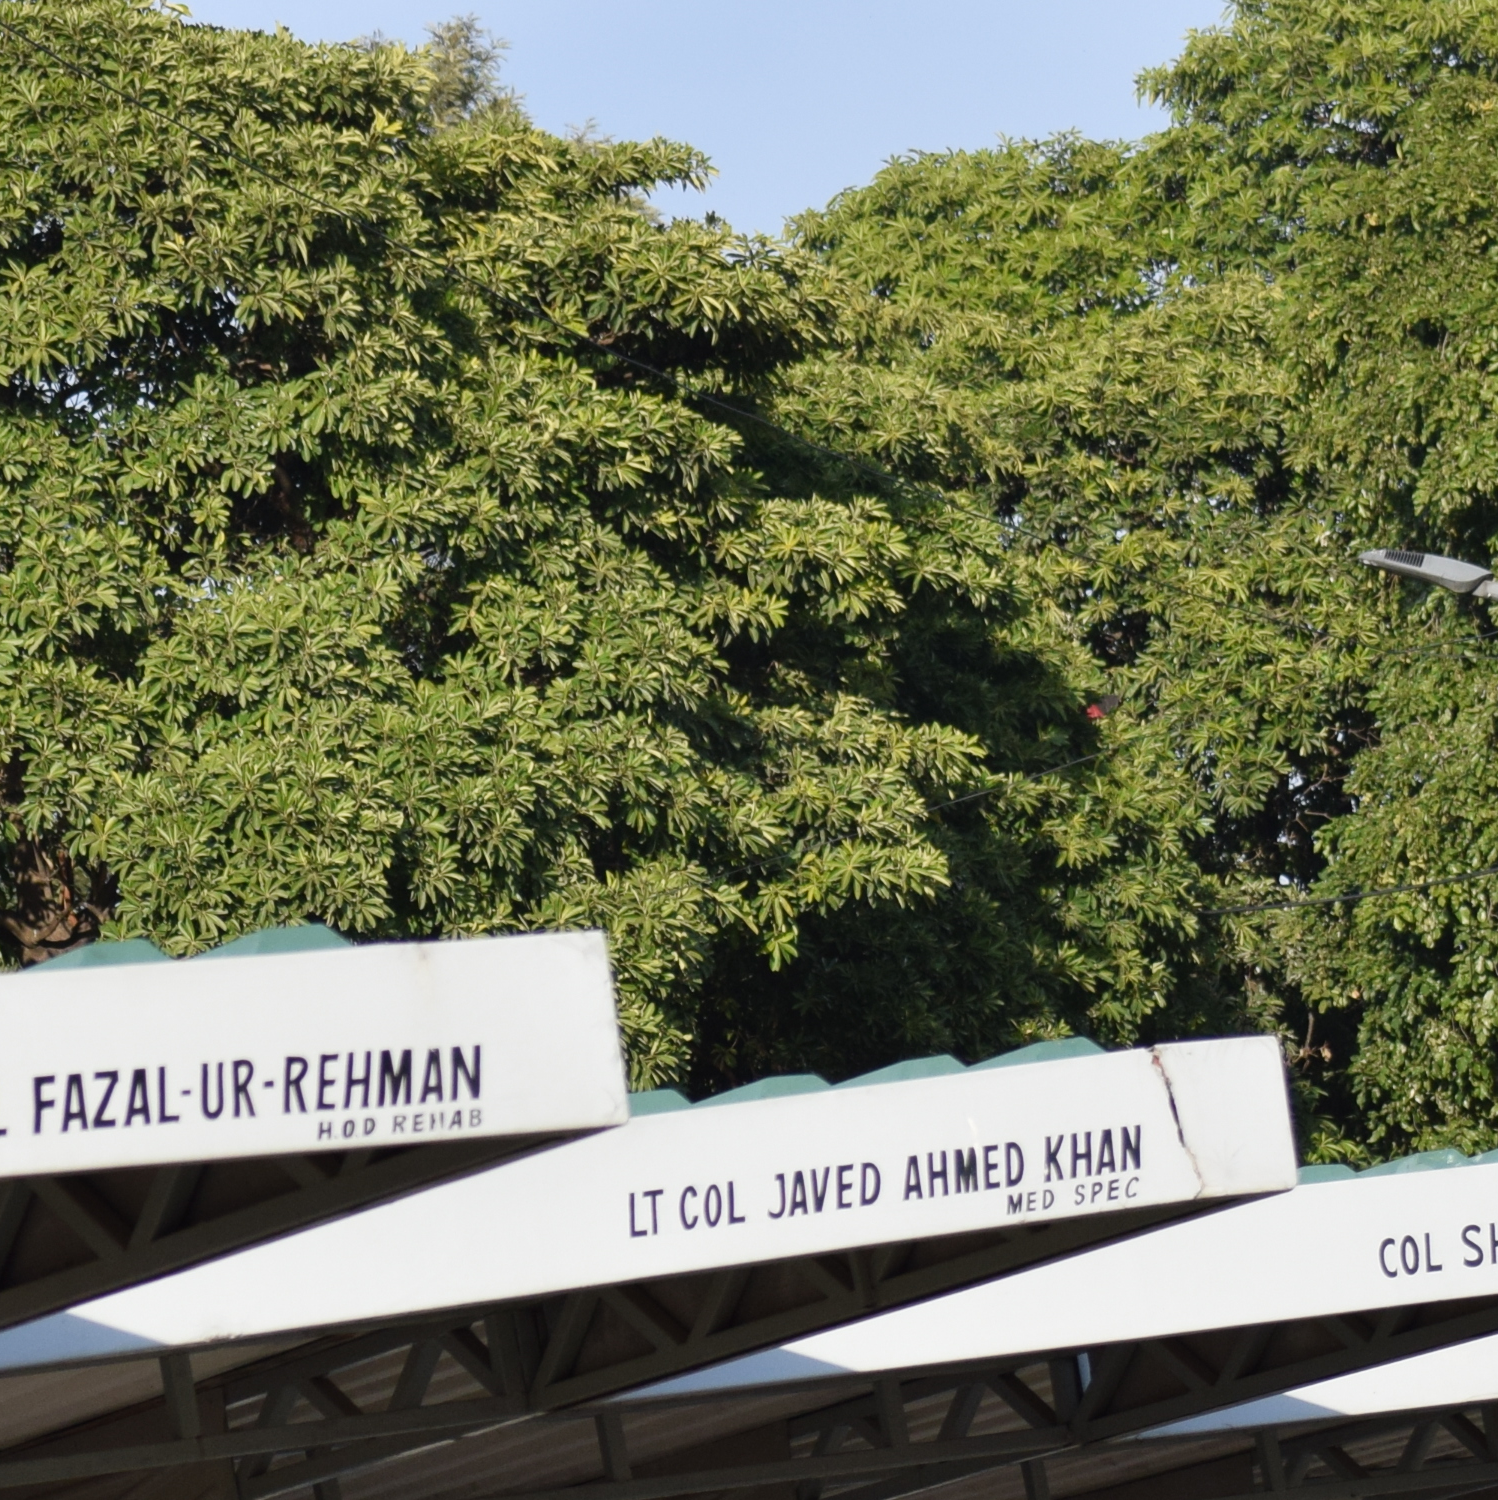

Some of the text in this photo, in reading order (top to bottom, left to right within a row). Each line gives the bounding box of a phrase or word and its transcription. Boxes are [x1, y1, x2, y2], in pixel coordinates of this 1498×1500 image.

[32, 1044, 482, 1135] FAZAL-UR-REHMAN
[629, 1124, 1142, 1238] LT COL JAVED AHMED KHAN
[1007, 1176, 1140, 1214] MED SPEC
[1379, 1232, 1443, 1279] COL
